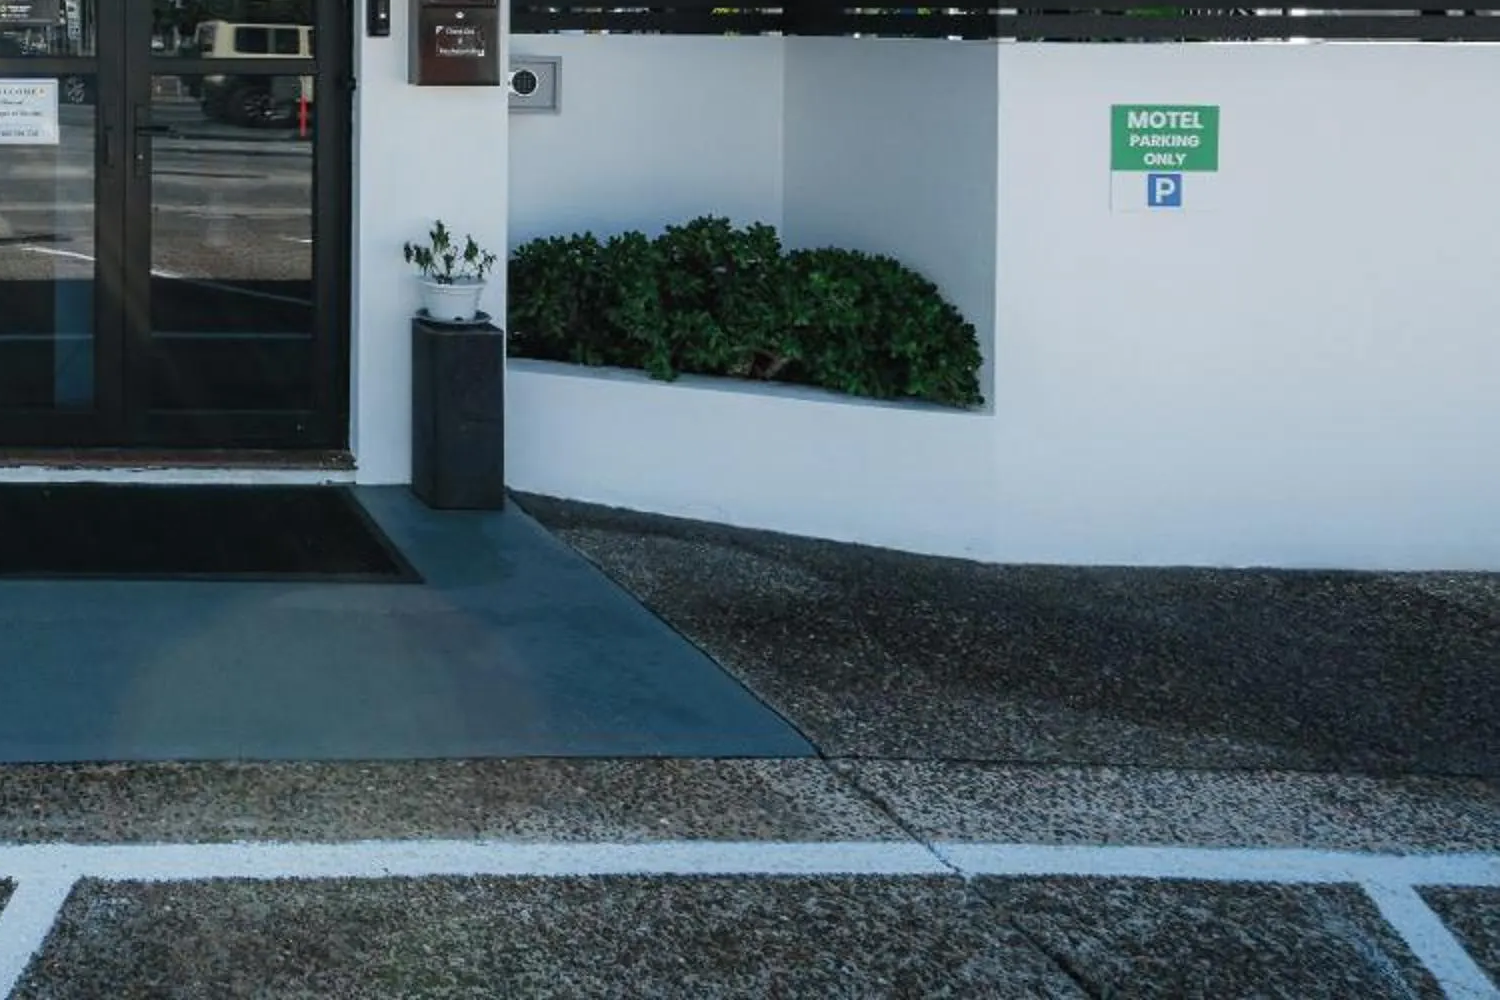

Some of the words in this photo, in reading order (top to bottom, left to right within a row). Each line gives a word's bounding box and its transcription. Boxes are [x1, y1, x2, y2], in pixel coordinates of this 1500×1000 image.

[1126, 111, 1204, 129] MOTEL
[1128, 133, 1201, 148] PARKING
[1143, 152, 1187, 166] ONLY
[1155, 177, 1176, 204] P
